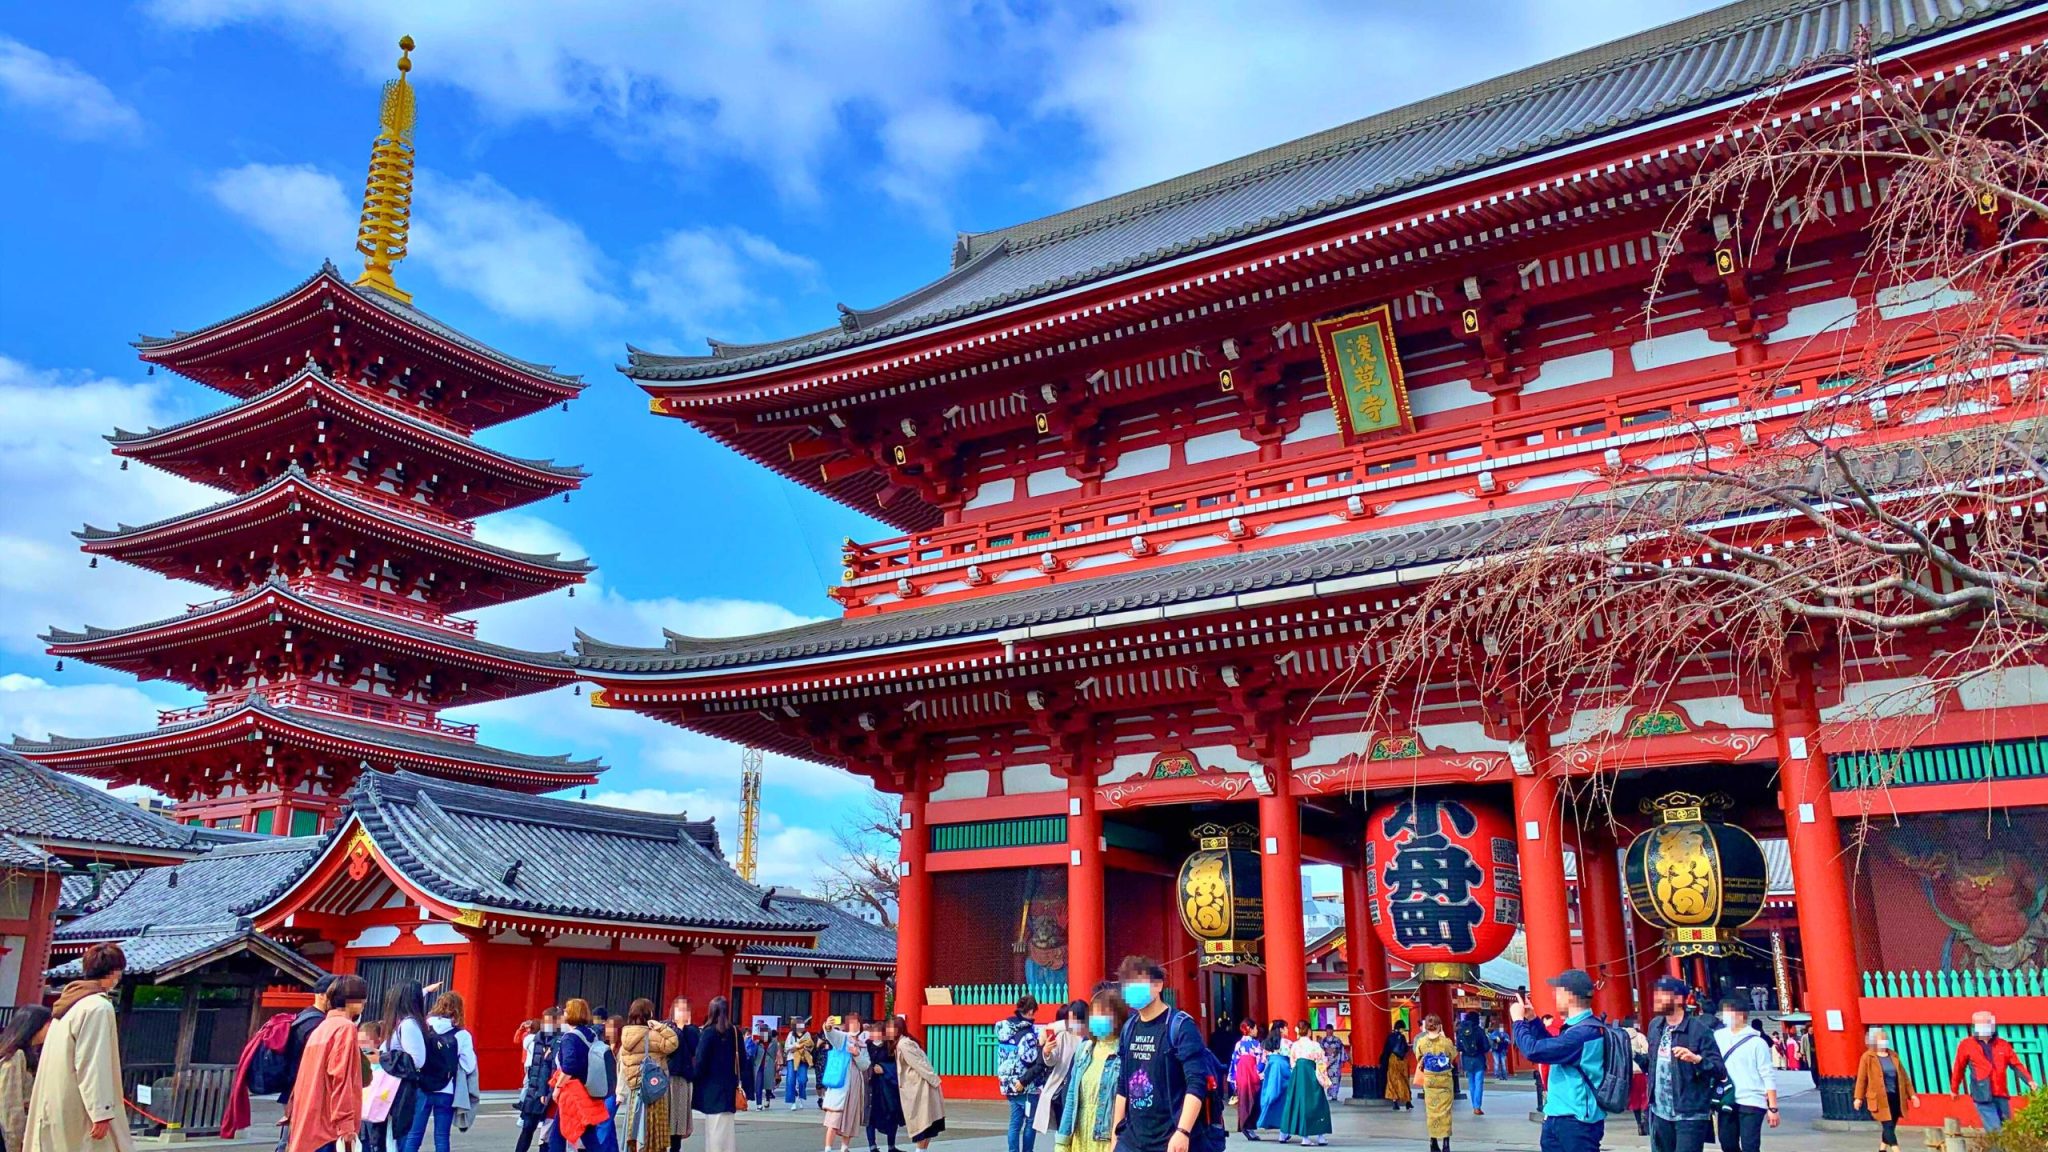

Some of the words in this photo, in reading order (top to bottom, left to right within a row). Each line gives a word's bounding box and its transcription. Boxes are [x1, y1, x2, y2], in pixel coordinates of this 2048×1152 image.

[1382, 799, 1486, 954] 小舟町
[1135, 1035, 1149, 1044] WHAT
[1129, 1043, 1156, 1052] BEAUTIFUL
[1133, 1052, 1152, 1060] WORLD
